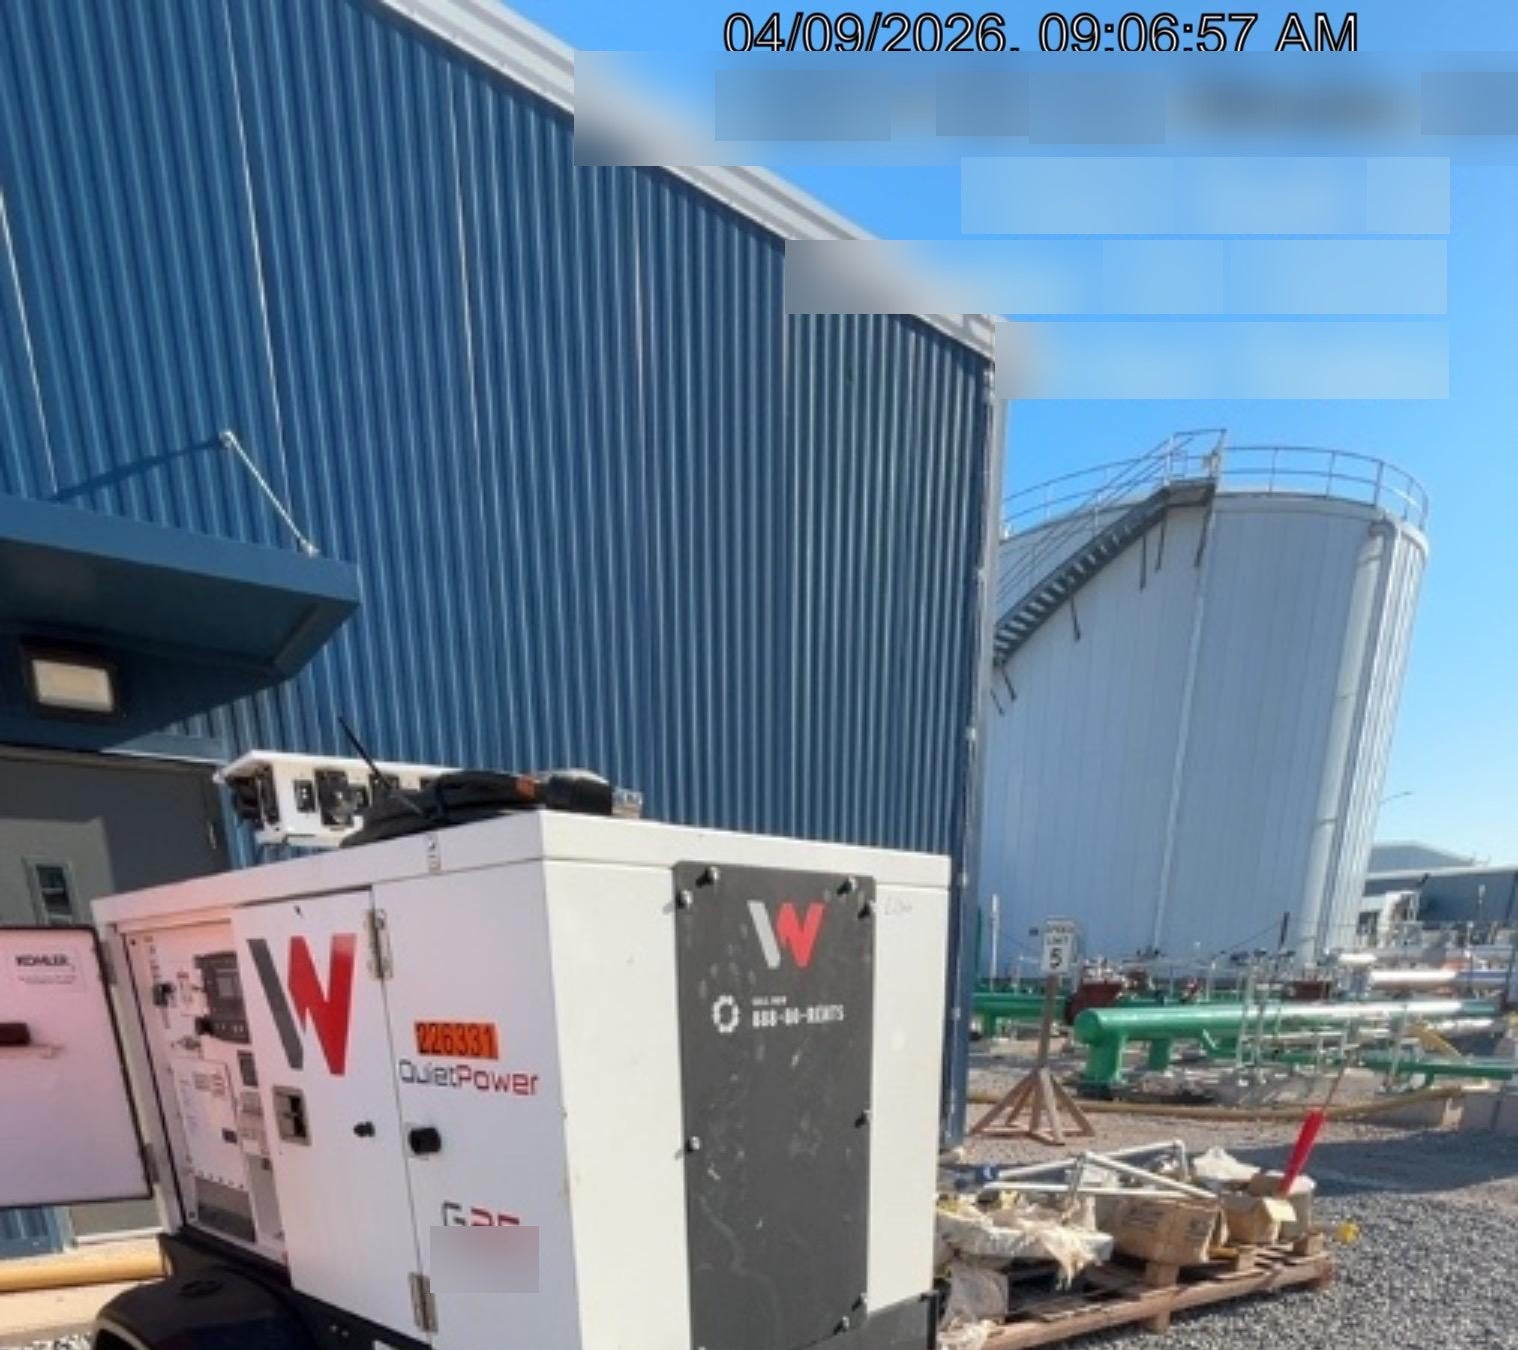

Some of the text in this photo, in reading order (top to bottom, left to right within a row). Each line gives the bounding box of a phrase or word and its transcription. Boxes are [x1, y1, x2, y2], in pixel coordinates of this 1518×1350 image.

[1050, 947, 1062, 970] 5
[416, 1023, 495, 1057] 226331
[399, 1058, 539, 1096] QuietPower
